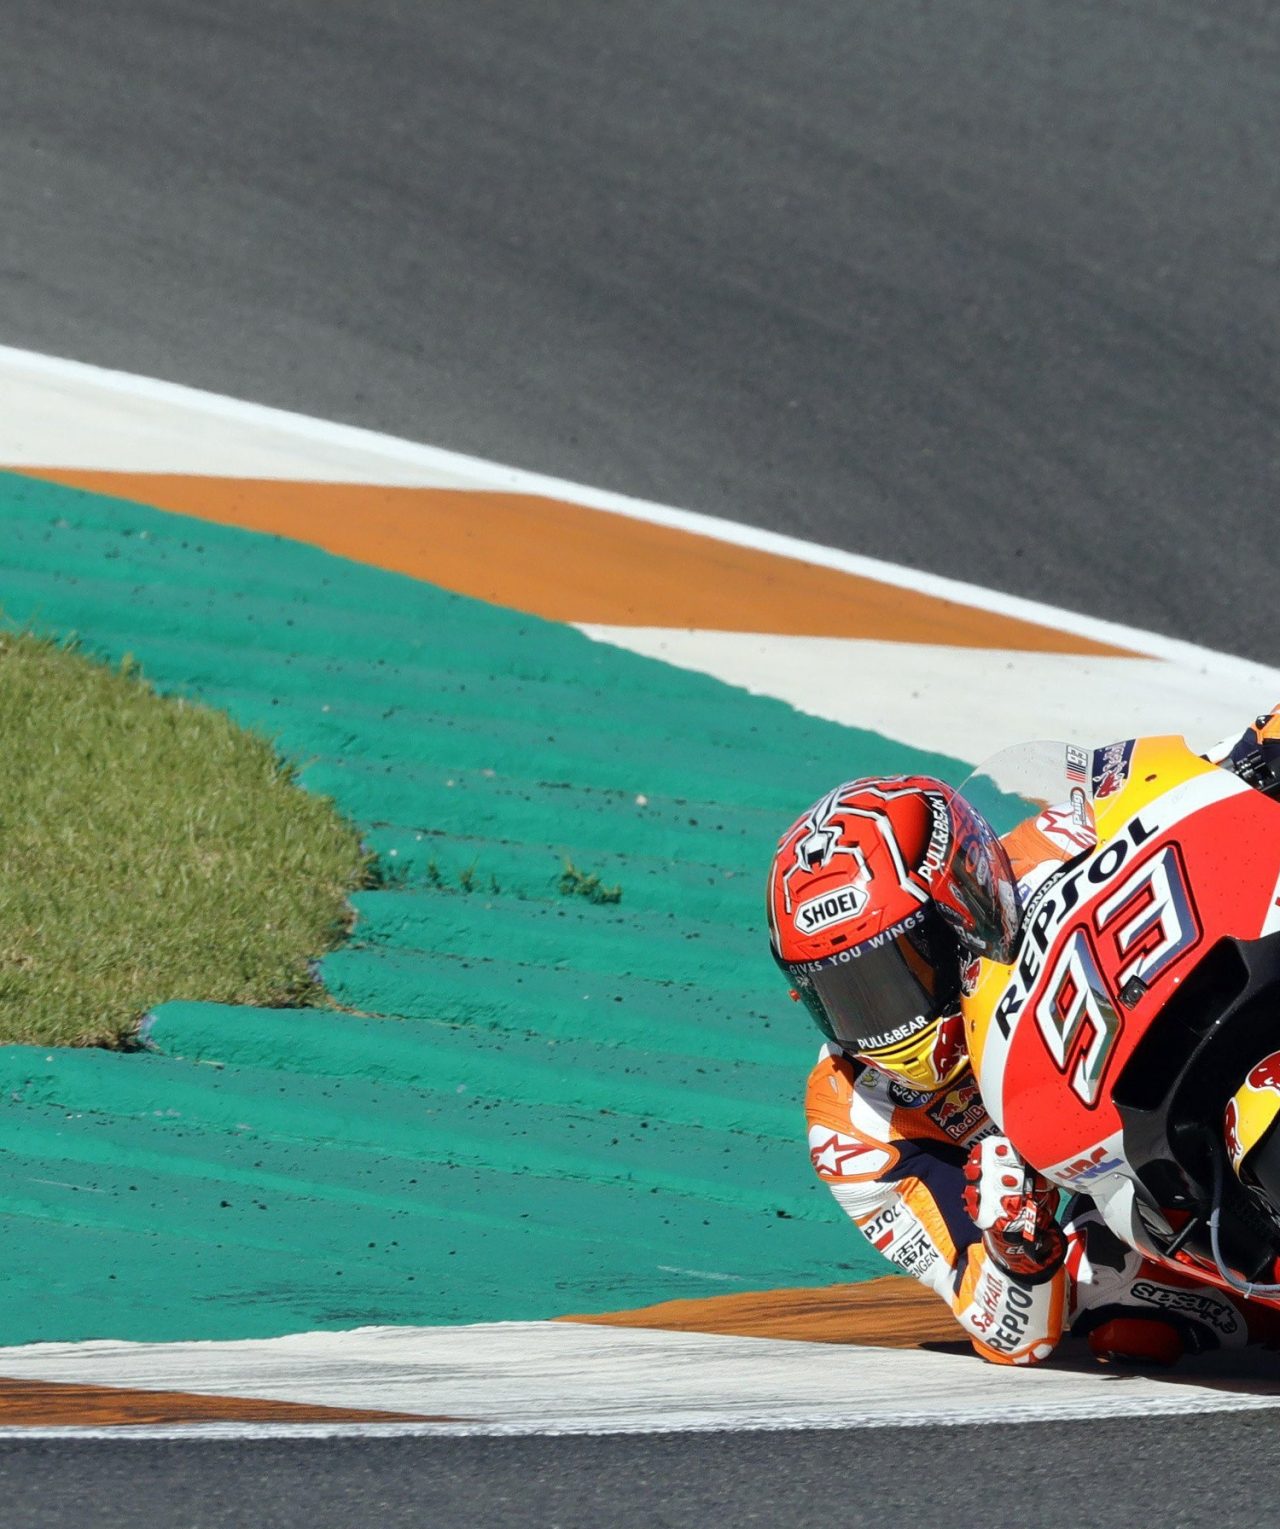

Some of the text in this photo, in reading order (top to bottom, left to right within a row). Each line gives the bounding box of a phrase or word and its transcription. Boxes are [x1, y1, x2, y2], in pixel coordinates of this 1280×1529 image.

[802, 891, 858, 929] SHOEI
[995, 814, 1160, 1042] REPSOL
[789, 911, 925, 975] GIVES YOU WINGS
[1035, 841, 1203, 1110] 93
[858, 1015, 928, 1050] PULL&BEAR
